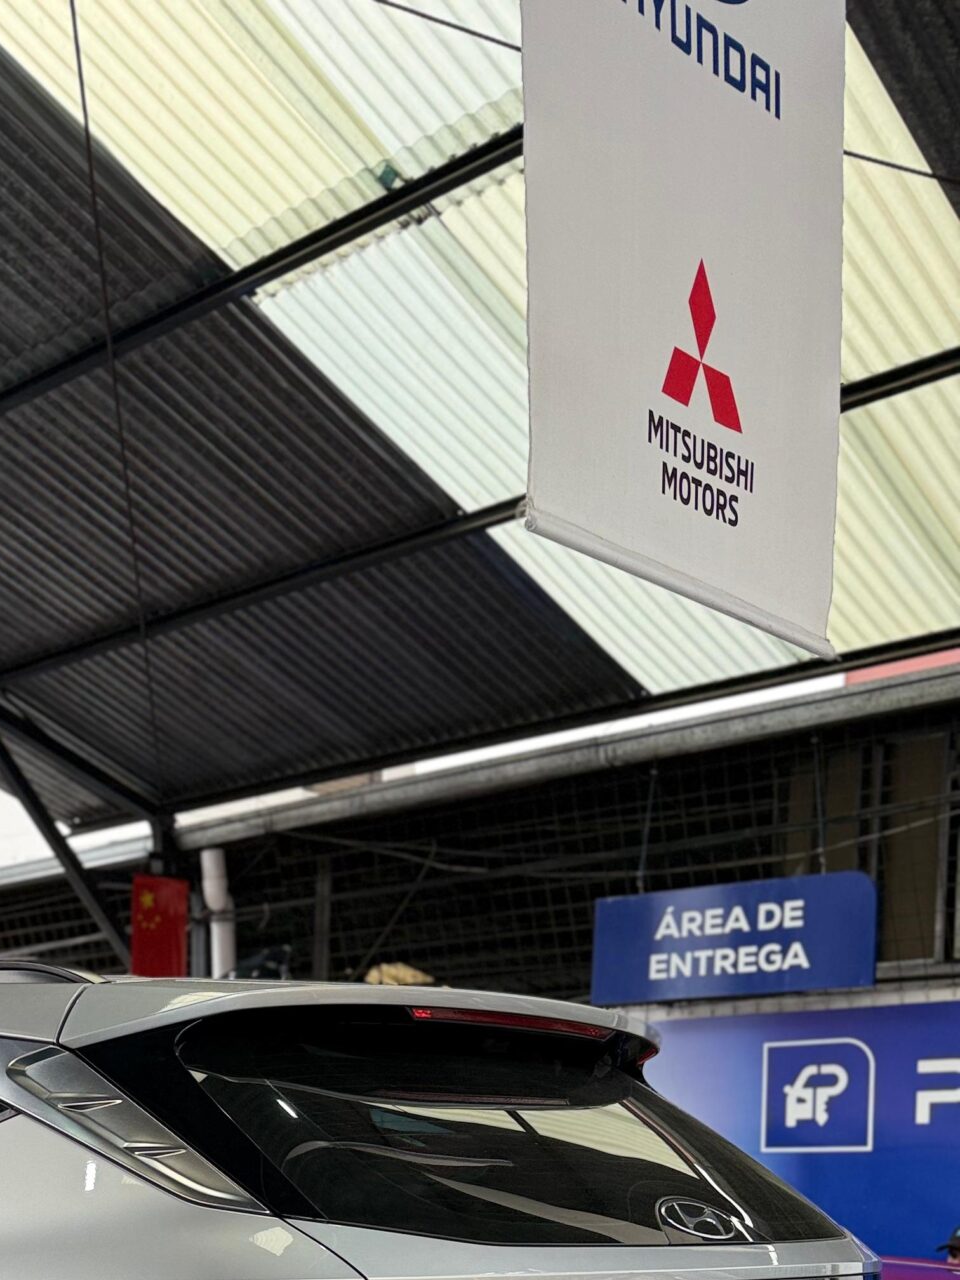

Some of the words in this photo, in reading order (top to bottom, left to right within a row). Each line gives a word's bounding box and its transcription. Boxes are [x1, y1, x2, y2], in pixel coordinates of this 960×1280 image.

[620, 0, 781, 120] YUNDAI
[647, 408, 755, 494] MITSUBISHI
[661, 460, 739, 527] MOTORS
[654, 905, 751, 941] ÁREA
[757, 899, 805, 931] DE
[648, 941, 811, 981] ENTREGA
